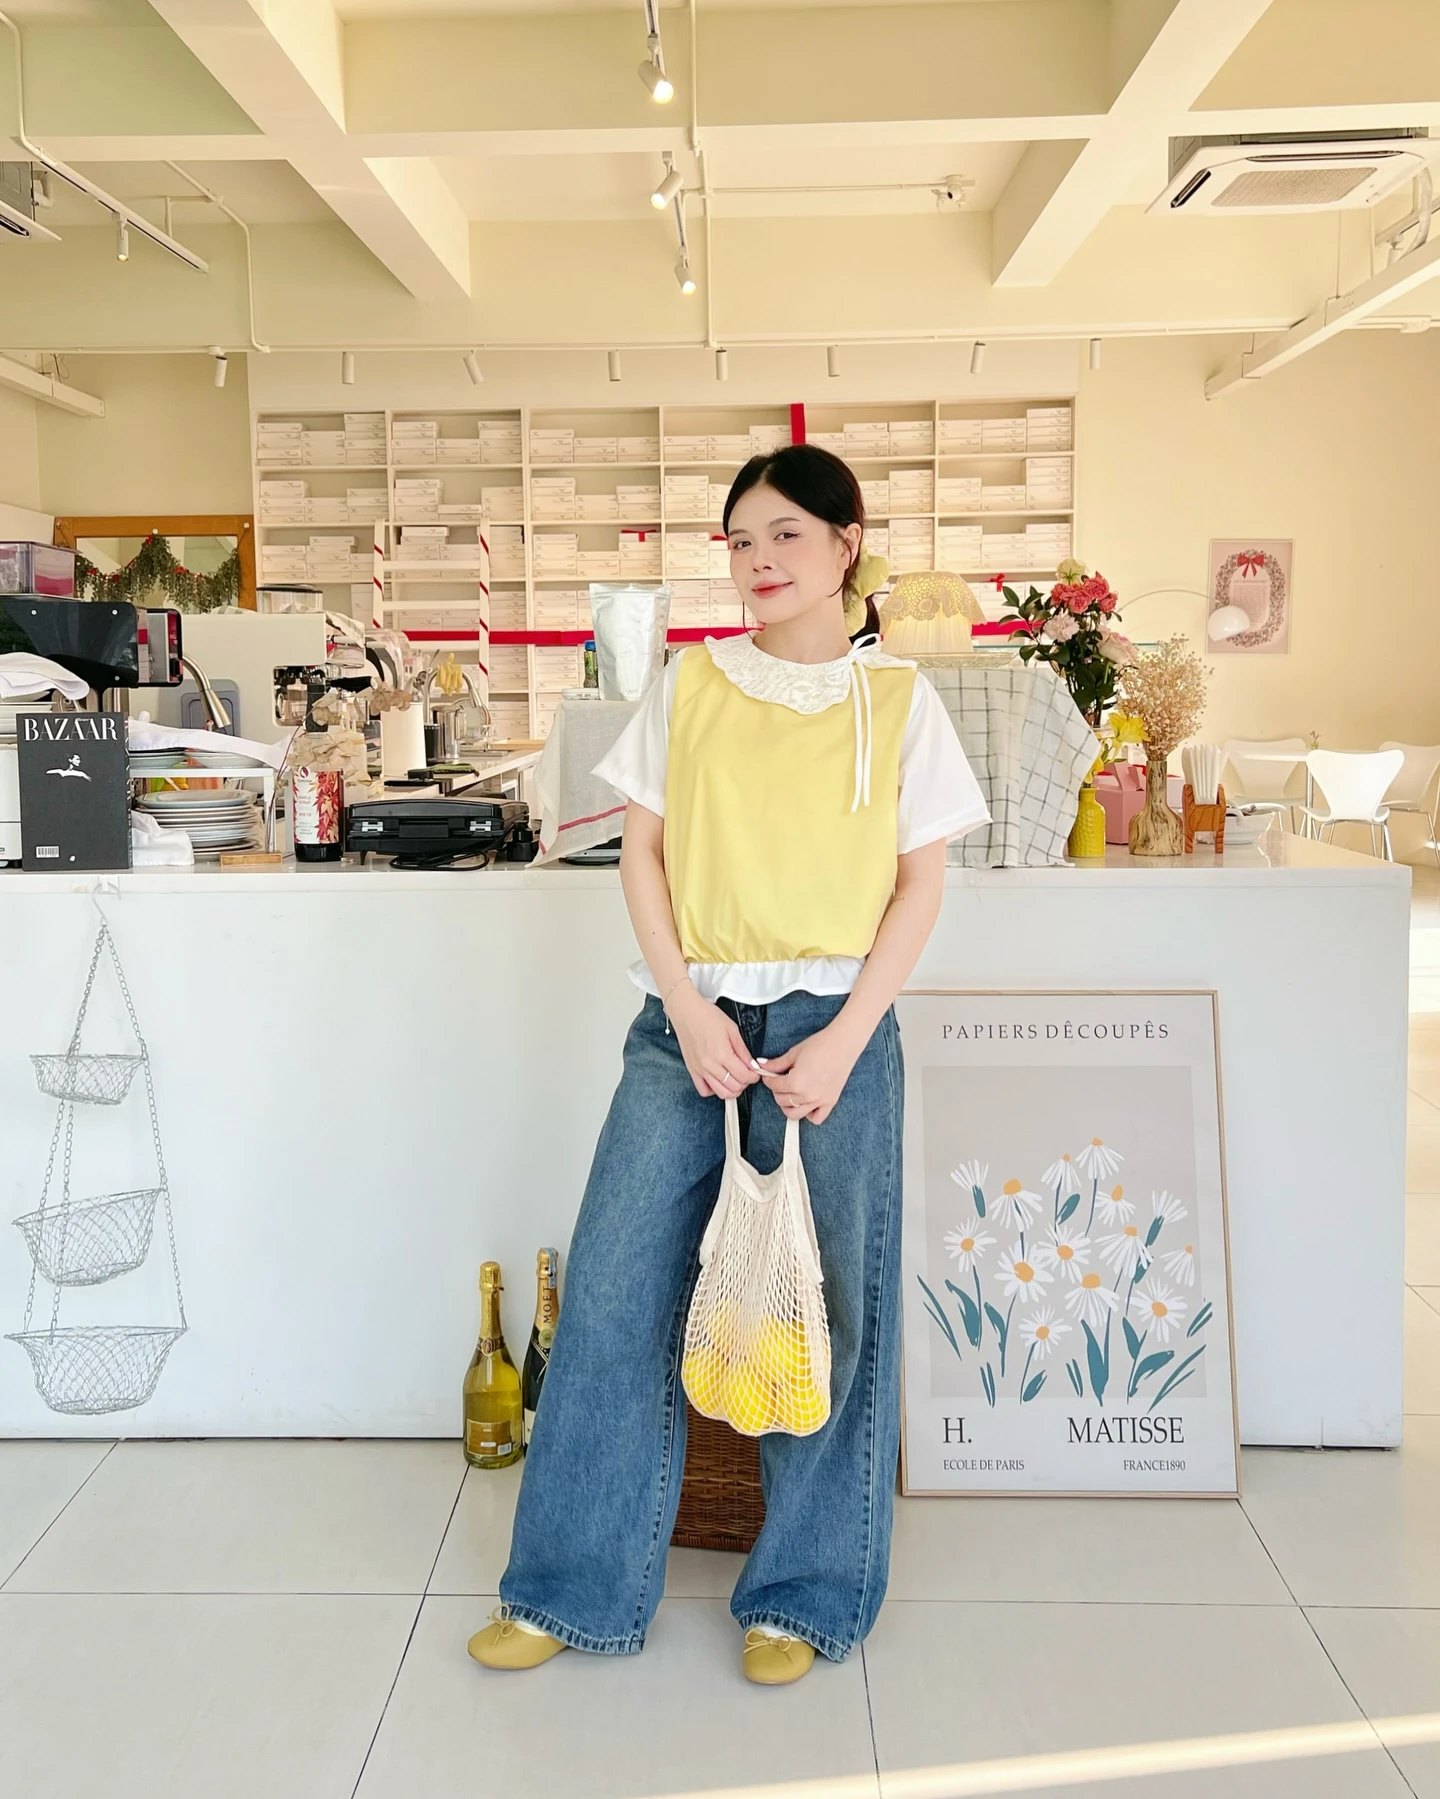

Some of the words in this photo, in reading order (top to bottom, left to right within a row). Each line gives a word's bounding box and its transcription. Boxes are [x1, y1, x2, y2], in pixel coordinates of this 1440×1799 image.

[24, 717, 118, 741] BAZAAR
[942, 1024, 1038, 1039] PAPIERS
[1045, 1020, 1169, 1039] DÊCOUPÊS
[942, 1417, 972, 1443] H.
[1067, 1416, 1185, 1444] MATISSE
[943, 1460, 978, 1470] ECOLE
[980, 1460, 994, 1470] DE
[996, 1460, 1025, 1470] PARIS
[1123, 1460, 1186, 1471] FRANCE1890
